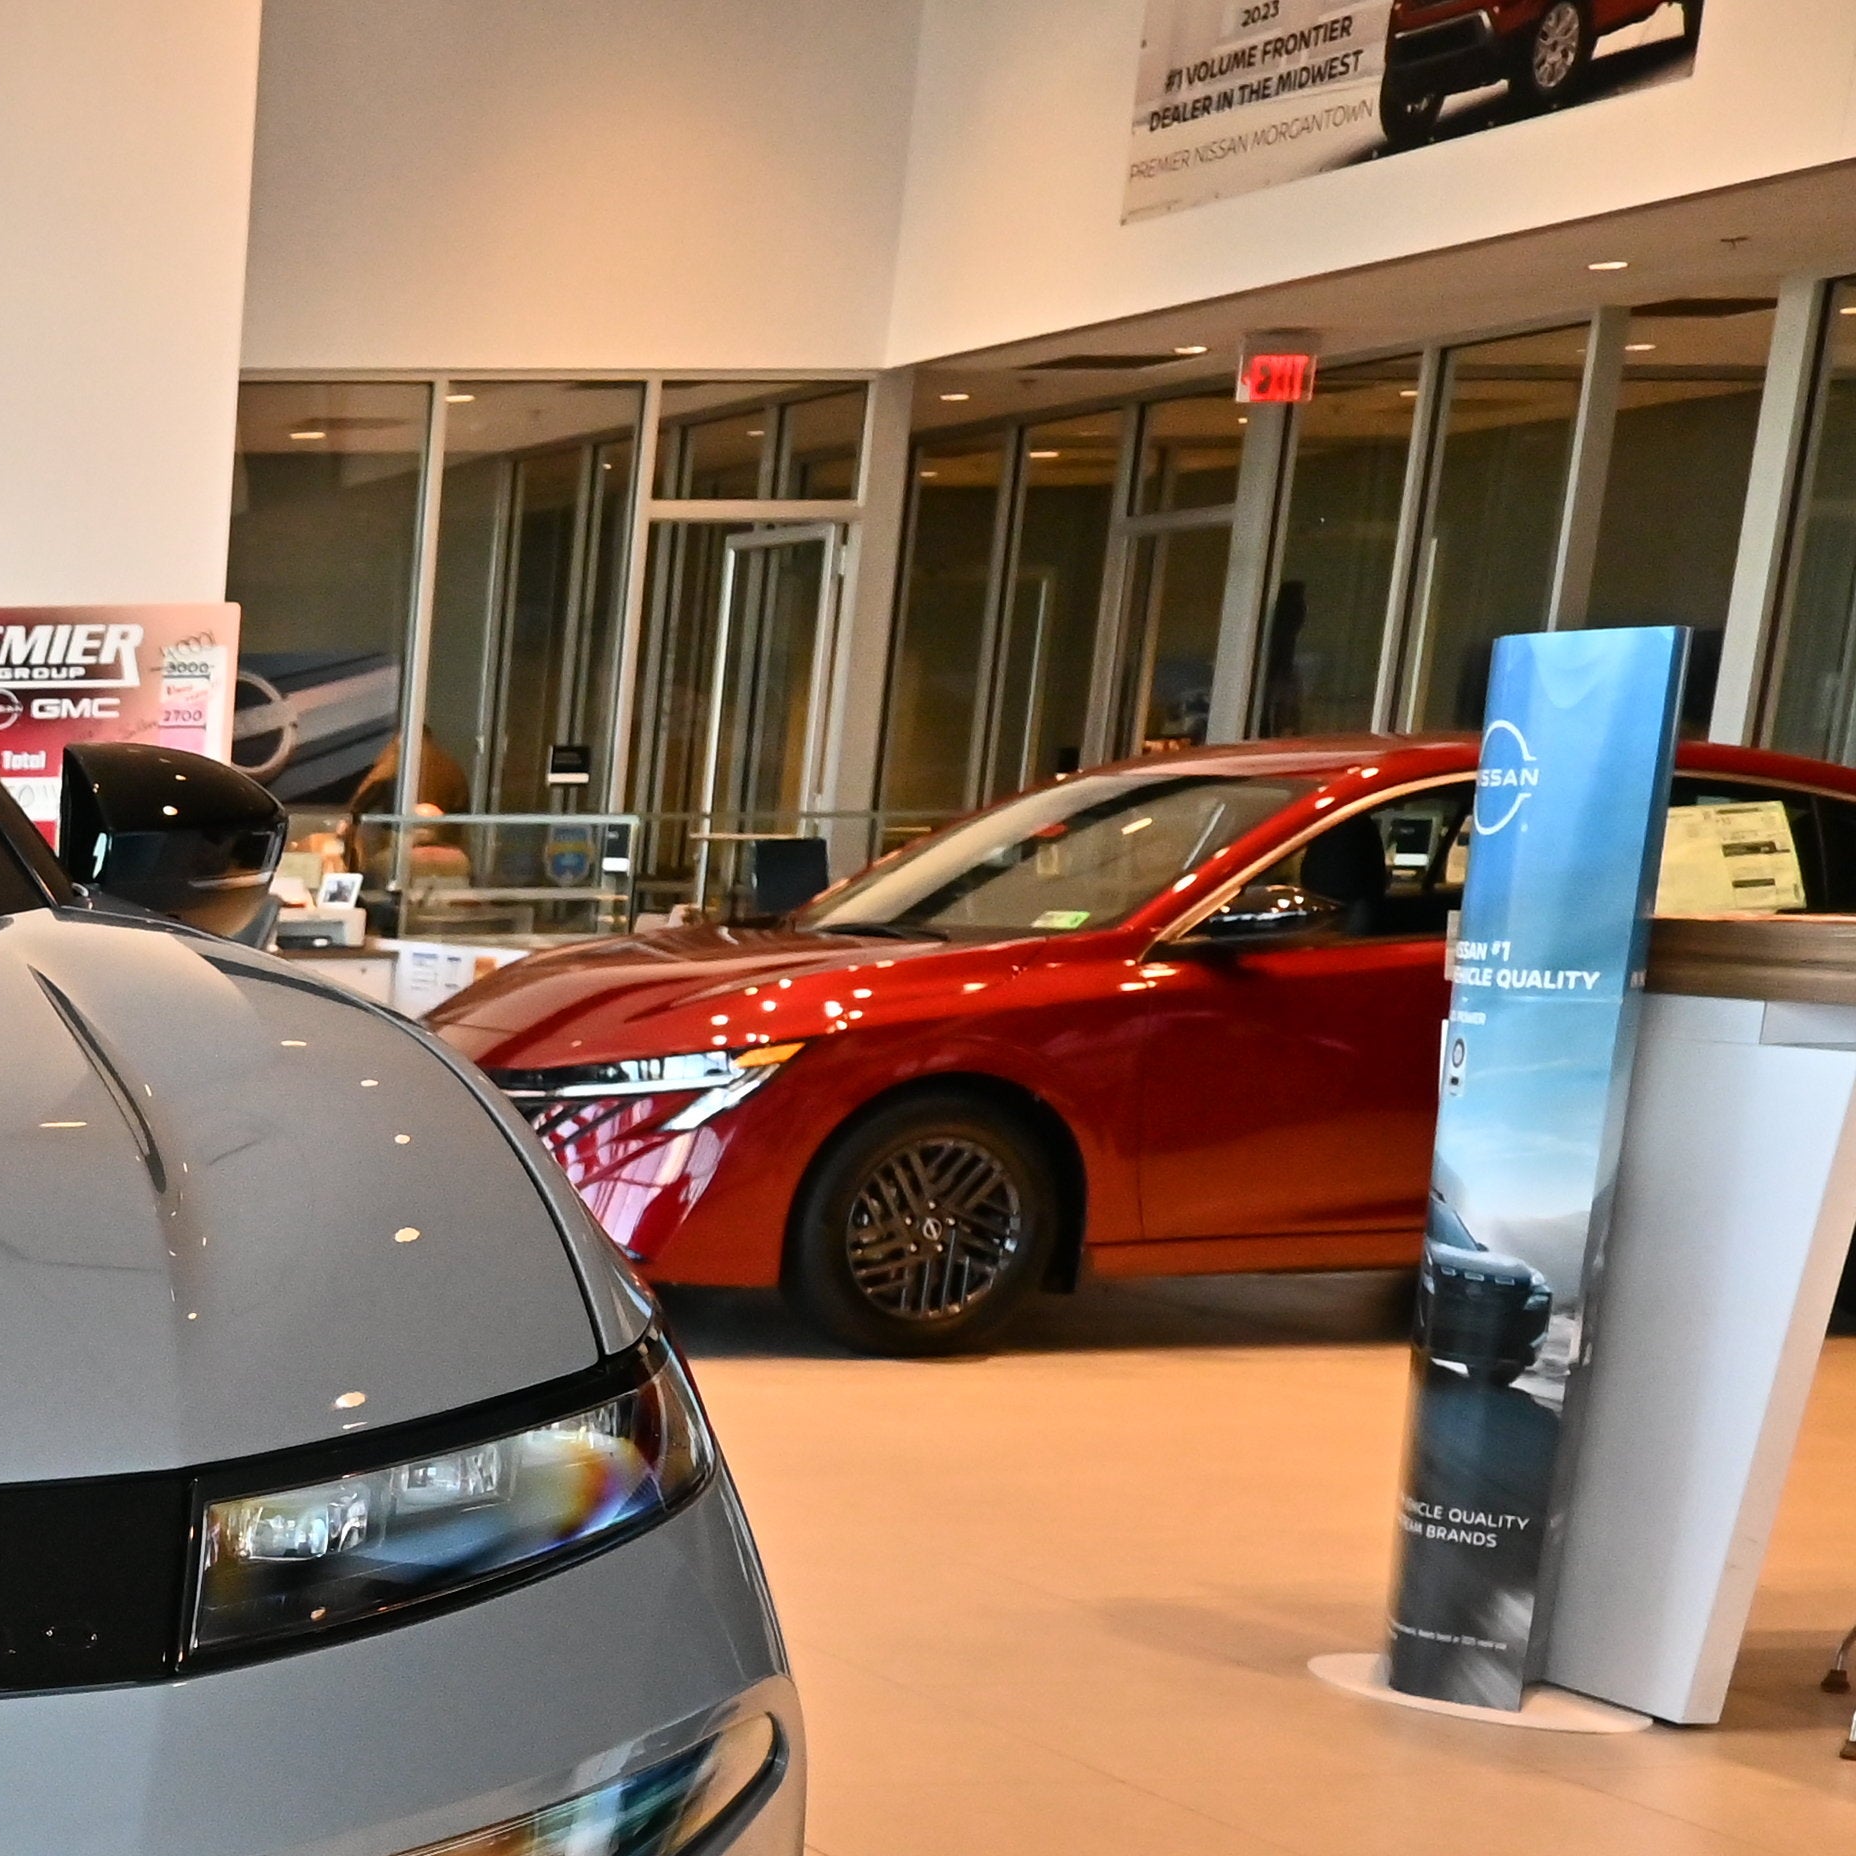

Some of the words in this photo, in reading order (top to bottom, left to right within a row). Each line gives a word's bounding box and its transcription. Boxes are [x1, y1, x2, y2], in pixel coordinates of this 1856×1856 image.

[1241, 0, 1280, 27] 2023
[1187, 45, 1258, 86] VOLUME
[1261, 15, 1354, 68] FRONTIER
[1149, 97, 1213, 132] DEALER
[1216, 88, 1234, 111] IN
[1238, 75, 1273, 105] THE
[1276, 49, 1365, 95] MIDWEST
[1130, 149, 1191, 179] PREMIER
[1193, 134, 1249, 164] NISSAN
[1249, 99, 1375, 151] MORGANTOWN
[31, 697, 121, 719] GMC
[1, 750, 47, 771] Total
[1496, 969, 1601, 990] QUALITY
[1448, 1507, 1530, 1531] QUALITY
[1425, 1524, 1498, 1548] BRANDS
